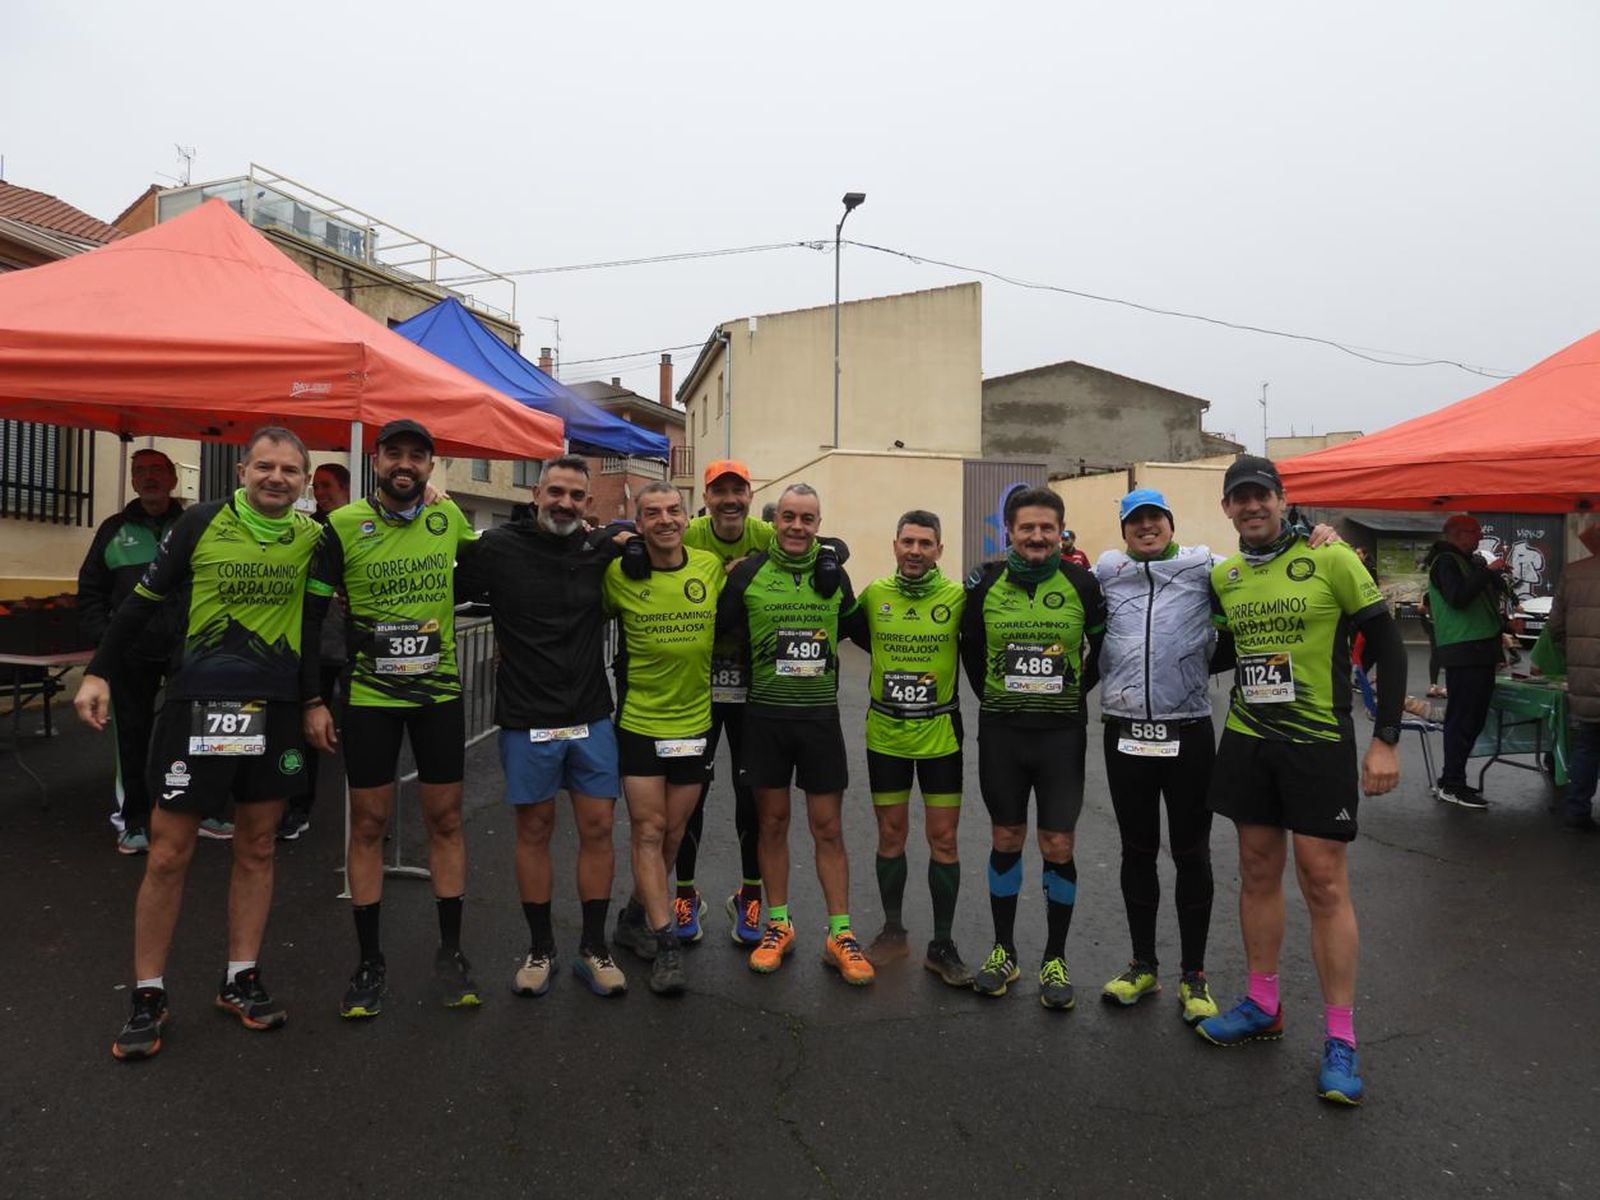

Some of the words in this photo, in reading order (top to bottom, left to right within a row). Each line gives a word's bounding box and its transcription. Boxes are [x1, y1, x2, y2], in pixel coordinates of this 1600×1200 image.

[218, 561, 299, 579] CORRECAMINOS
[367, 552, 448, 580] CORRECAMINOS
[218, 580, 294, 597] CARBAJOSA
[370, 573, 448, 598] CARBAJOSA
[374, 592, 446, 606] SALAMANCA
[764, 602, 831, 613] CORRECAMINOS
[635, 610, 713, 624] CORRECAMINOS
[771, 615, 823, 624] CARBAJOSA
[994, 620, 1070, 630] CORRECAMINOS
[645, 622, 705, 635] CARBAJOSA
[1233, 616, 1306, 637] ARBAJOSA
[655, 636, 698, 644] SALAMANCA
[876, 632, 950, 644] CORRECAMINOS
[1001, 631, 1061, 641] CARBAJOSA
[389, 636, 429, 655] 387
[786, 641, 820, 659] 490
[883, 643, 940, 654] CARBAJOSA
[890, 655, 932, 663] SALAMANCA
[1015, 657, 1053, 675] 486
[1244, 665, 1282, 686] 1124
[891, 685, 928, 702] 482
[207, 713, 252, 734] 787
[1131, 722, 1168, 740] 589
